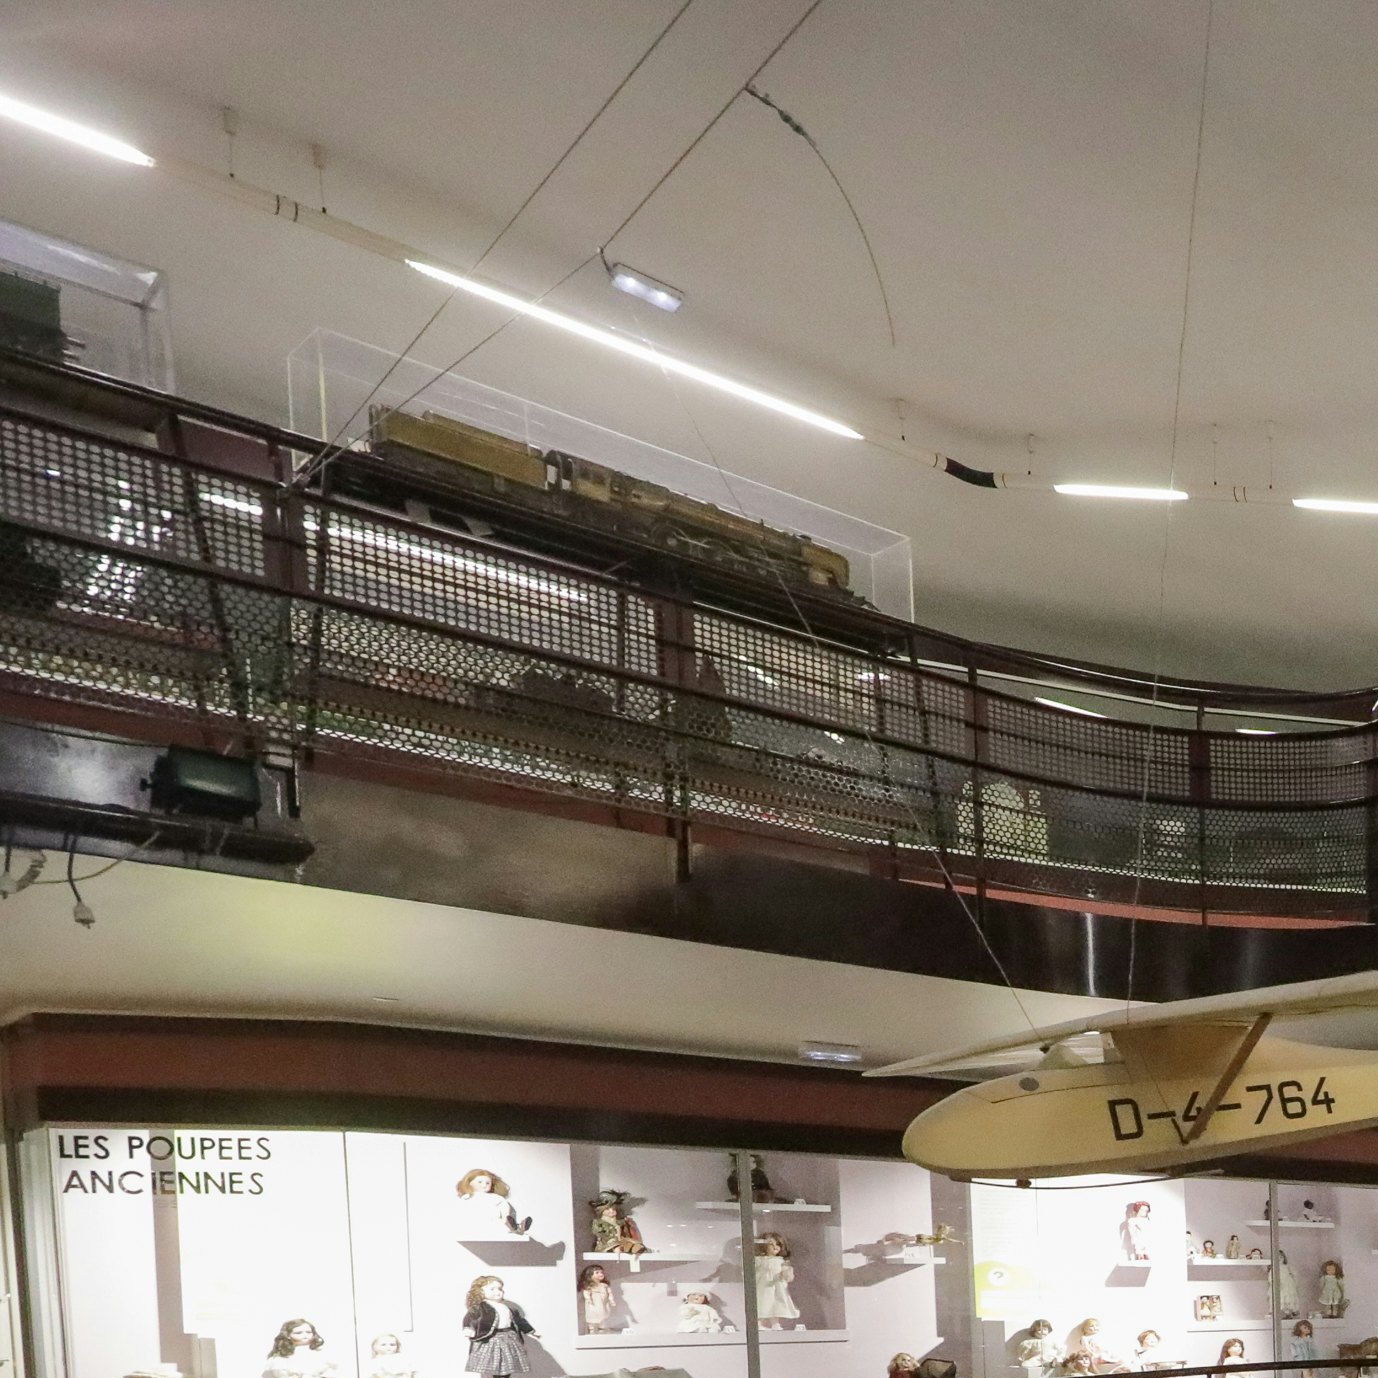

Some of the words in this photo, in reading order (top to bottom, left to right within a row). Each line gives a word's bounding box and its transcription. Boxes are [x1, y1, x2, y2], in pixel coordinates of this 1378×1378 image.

[57, 1134, 111, 1160] LES
[126, 1135, 272, 1161] POUPEES
[62, 1169, 265, 1196] ANCIENNES
